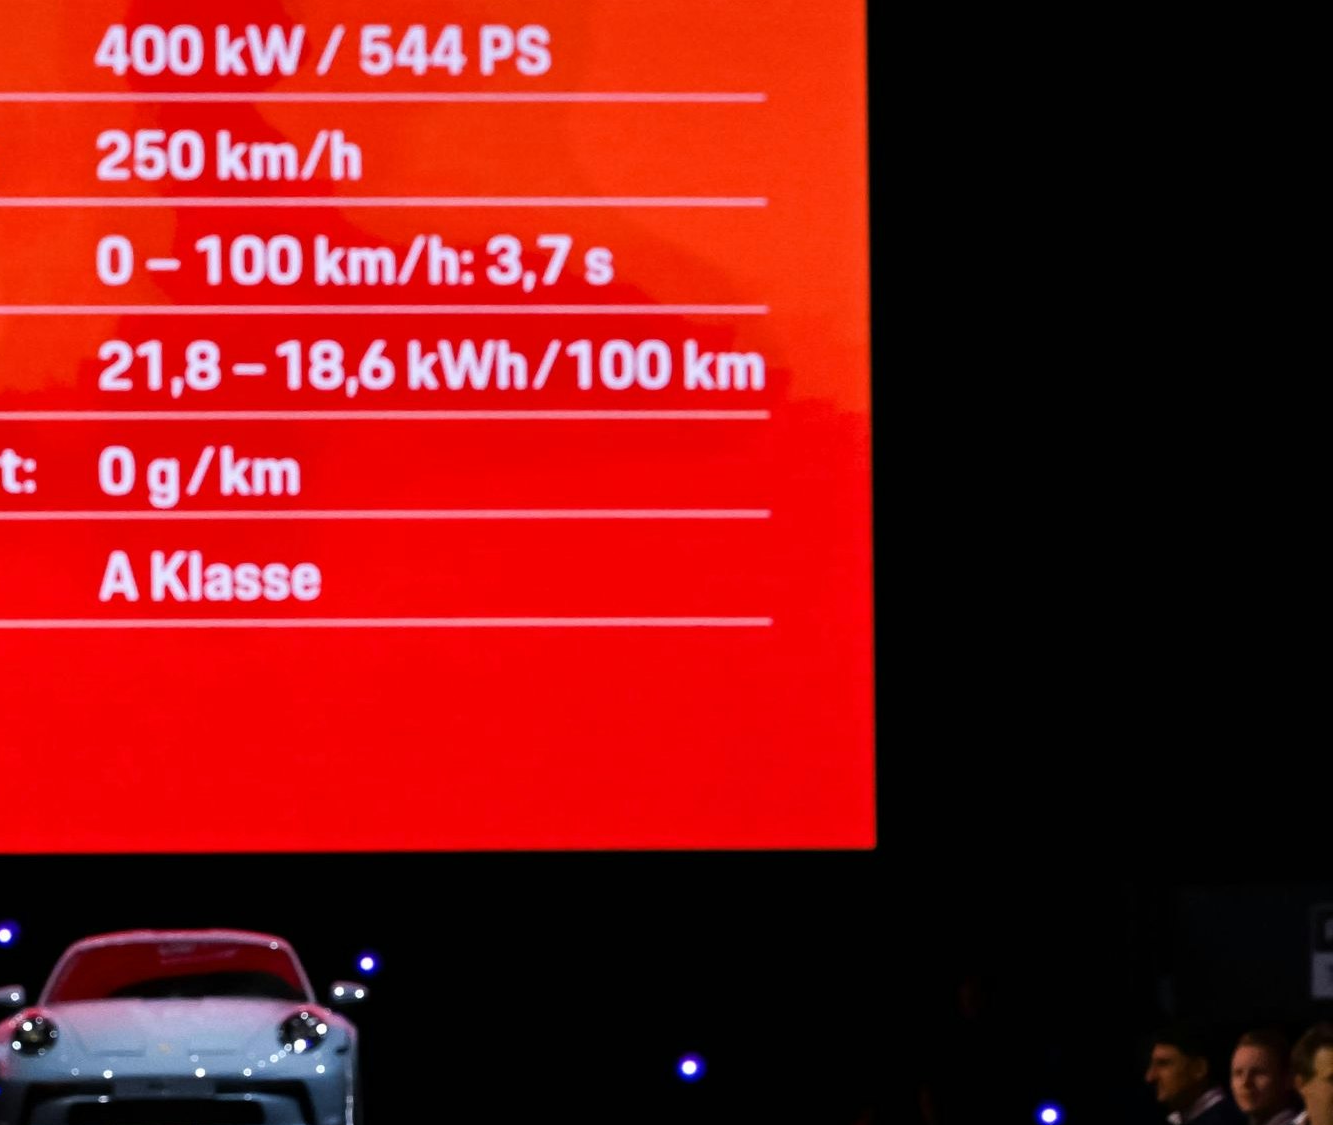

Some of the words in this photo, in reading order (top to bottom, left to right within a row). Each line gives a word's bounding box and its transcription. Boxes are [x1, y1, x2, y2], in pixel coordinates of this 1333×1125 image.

[94, 25, 203, 75] 400
[215, 25, 305, 75] kW
[317, 25, 345, 75] /
[359, 25, 467, 75] 544
[479, 25, 552, 75] PS
[95, 130, 204, 180] 250
[216, 130, 362, 180] km/h
[95, 235, 134, 285] 0
[195, 235, 303, 285] 100
[313, 235, 475, 285] km/h:
[486, 234, 573, 291] 3,7
[584, 247, 614, 285] s
[98, 340, 221, 397] 21,8
[275, 340, 395, 397] 18,6
[683, 339, 765, 390] km
[98, 446, 135, 495] 0
[146, 445, 301, 508] g/km
[98, 551, 139, 601] A
[150, 550, 321, 601] Klasse
